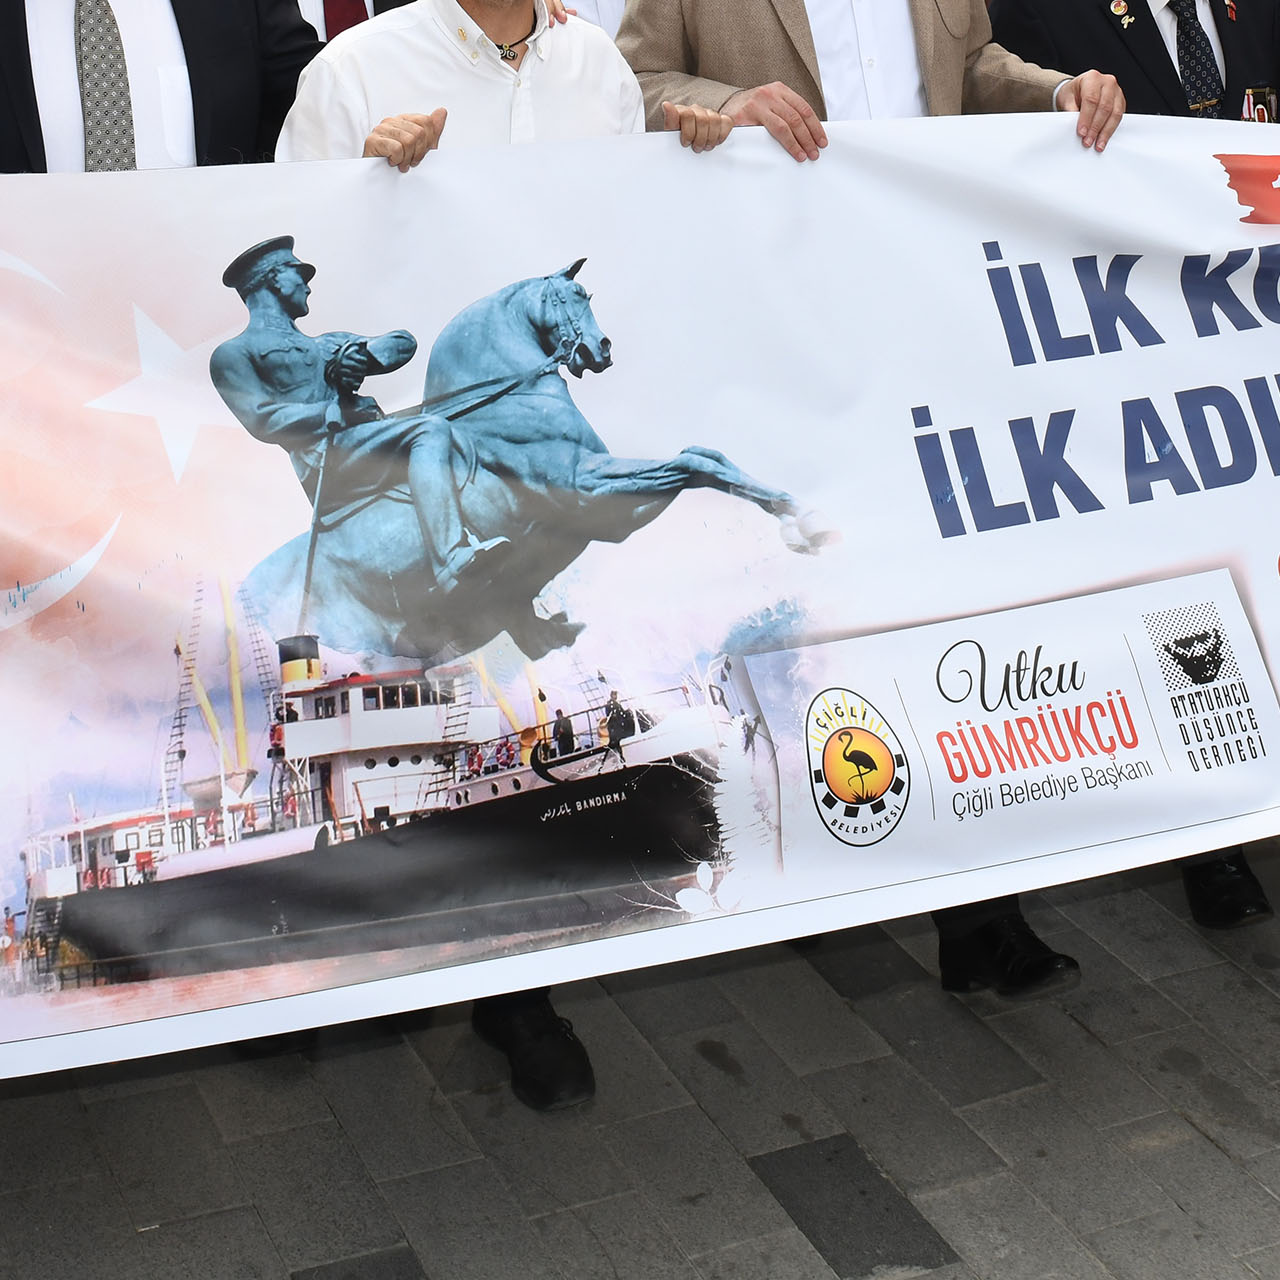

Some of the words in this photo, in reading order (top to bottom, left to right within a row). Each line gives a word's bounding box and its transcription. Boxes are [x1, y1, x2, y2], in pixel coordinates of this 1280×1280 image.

[981, 241, 1167, 367] İLK
[910, 404, 1106, 540] İLK
[935, 638, 1086, 714] Utku
[814, 700, 871, 731] ÇİĞLİ
[1170, 677, 1251, 720] ATATÜRKÇÜ
[936, 688, 1140, 784] GÜMRÜKÇÜ
[1178, 707, 1259, 746] DÜŞÜNCE
[1187, 730, 1267, 772] DERNEĞİ
[575, 791, 627, 812] BANDIRMA
[951, 780, 995, 822] Çiğli
[1000, 771, 1079, 808] Belediye
[1083, 758, 1154, 792] Başkanı
[829, 803, 903, 834] BELEDİYESİ
